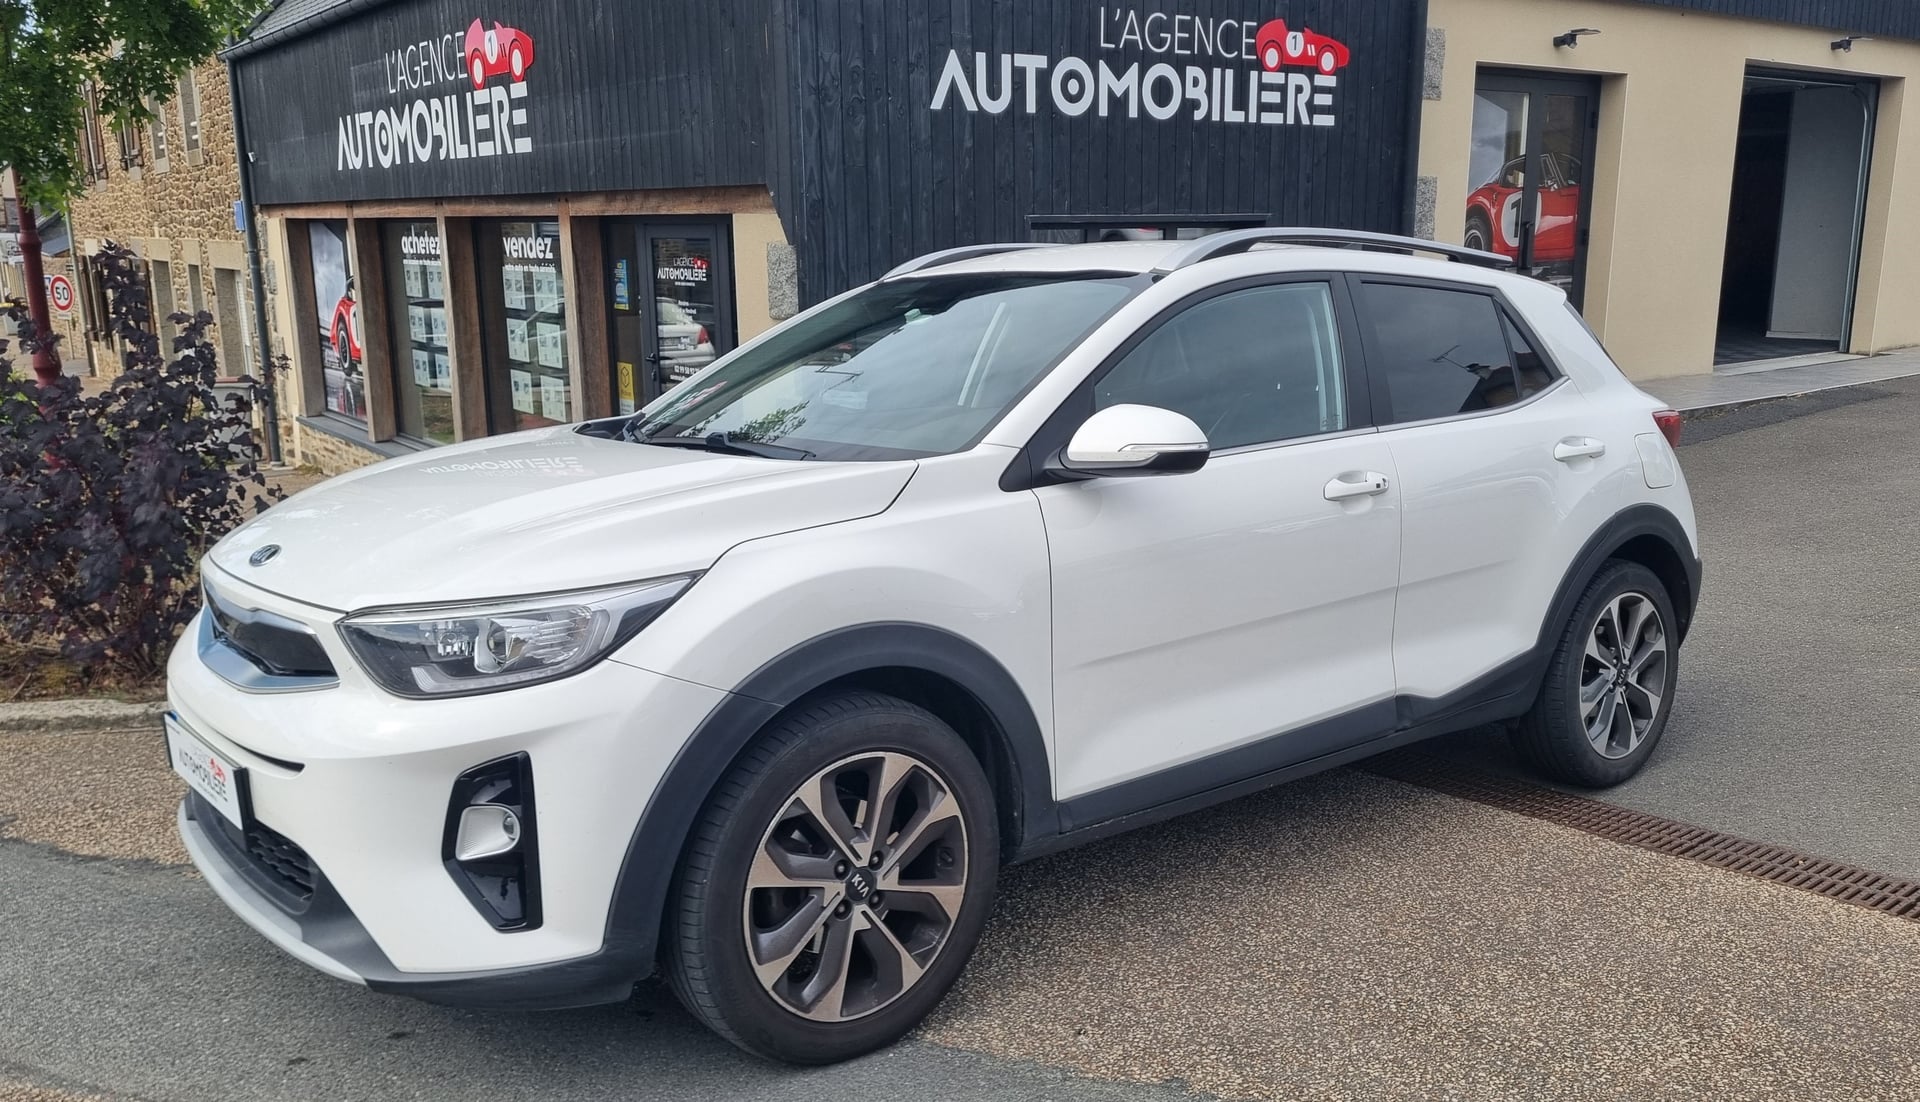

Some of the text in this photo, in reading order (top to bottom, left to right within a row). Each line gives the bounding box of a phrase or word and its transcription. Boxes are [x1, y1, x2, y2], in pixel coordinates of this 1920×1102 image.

[487, 35, 495, 57] 1
[1100, 6, 1258, 60] L'AGENCE
[1291, 34, 1300, 52] 1
[385, 31, 468, 94] L'AGENCE
[401, 224, 441, 255] achetez
[502, 224, 554, 259] vendez
[55, 286, 70, 301] 50
[851, 873, 870, 898] KIA
